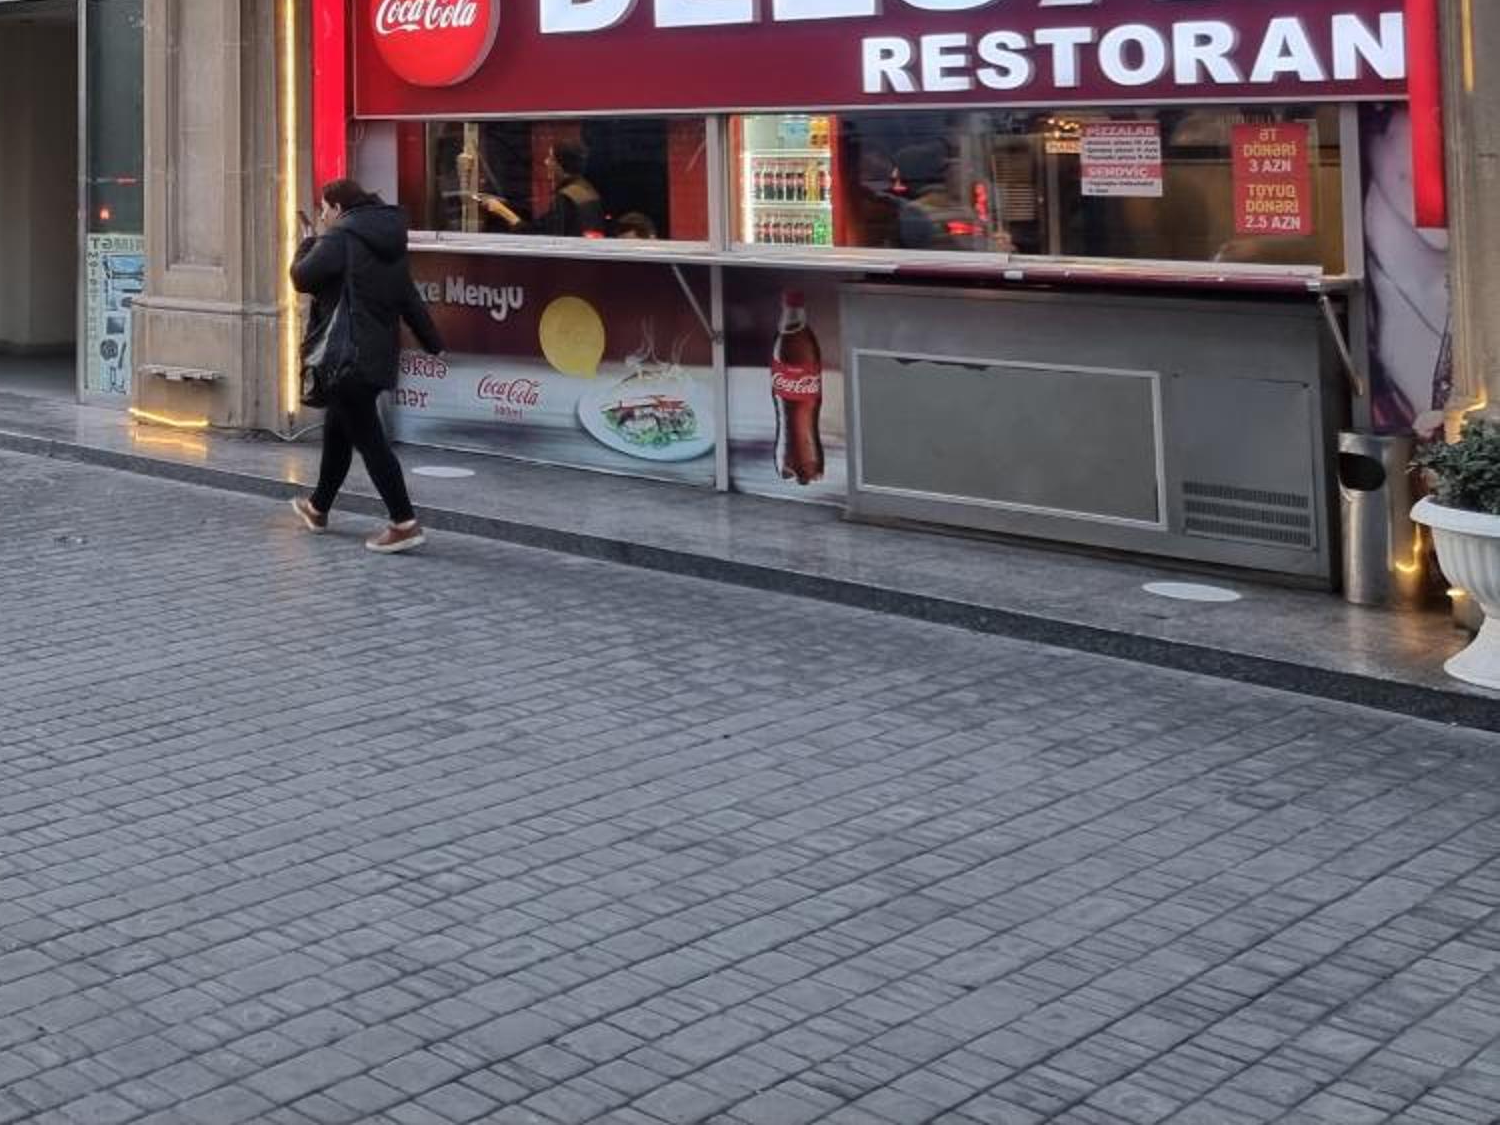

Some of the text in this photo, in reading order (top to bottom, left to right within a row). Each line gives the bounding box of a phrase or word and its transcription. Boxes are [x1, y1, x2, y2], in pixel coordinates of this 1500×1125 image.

[862, 12, 1406, 93] RESTORAN
[1248, 159, 1292, 172] 3 AZN
[1247, 183, 1296, 198] TOYUQ
[1245, 215, 1301, 230] 2.5 AZN
[445, 277, 523, 321] Menyu
